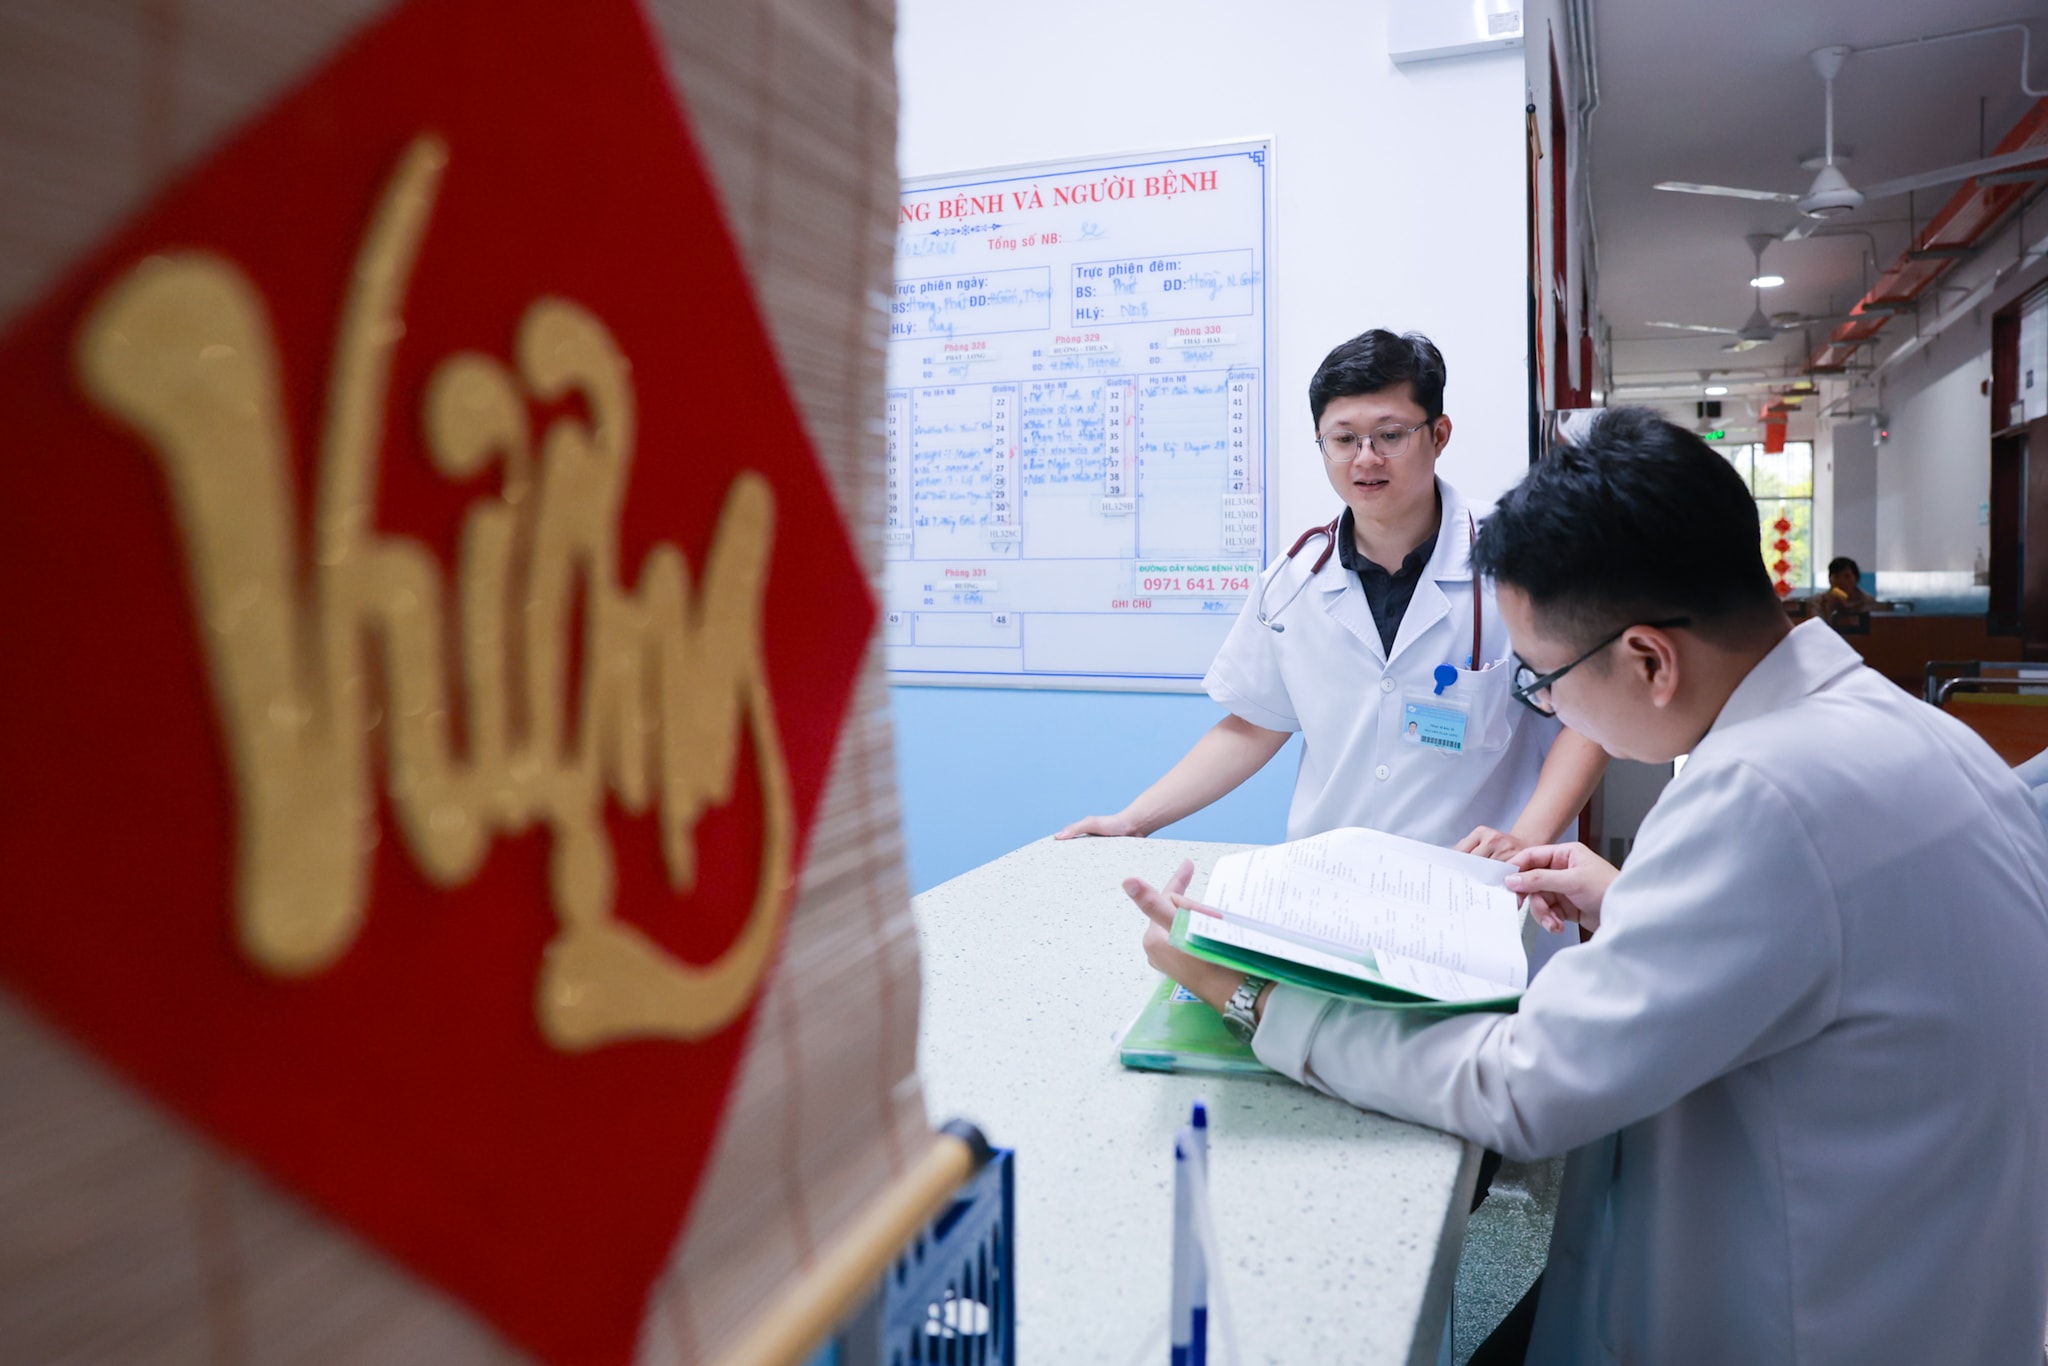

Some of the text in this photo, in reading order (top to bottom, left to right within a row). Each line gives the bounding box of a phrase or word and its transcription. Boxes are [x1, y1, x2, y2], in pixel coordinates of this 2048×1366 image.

[899, 169, 1218, 224] NG BỆNH VÀ NGƯỜI BỆNH
[988, 232, 1062, 251] Tổng số NB:
[1076, 260, 1181, 280] Trực phiên đêm:
[920, 279, 951, 295] phiên
[957, 276, 988, 291] ngày:
[1163, 279, 1187, 292] ĐD:
[1076, 286, 1096, 298] BS:
[969, 295, 990, 308] ĐD:
[1076, 307, 1104, 321] HLý:
[1174, 325, 1221, 336] Phòng 330
[1055, 333, 1100, 344] Phòng 329
[944, 343, 968, 353] Phòng
[1232, 384, 1243, 392] 40
[996, 398, 1005, 406] 22
[1232, 398, 1243, 406] 41
[996, 411, 1005, 419] 23
[1232, 412, 1243, 420] 42
[1110, 419, 1119, 427] 34
[1232, 426, 1243, 434] 43
[1232, 440, 1243, 448] 44
[1110, 446, 1119, 454] 36
[996, 451, 1005, 459] 26
[1232, 455, 1243, 463] 45
[996, 464, 1005, 472] 27
[1110, 473, 1119, 481] 38
[1232, 469, 1243, 477] 46
[1110, 486, 1119, 494] 39
[1232, 482, 1243, 490] 47
[996, 491, 1005, 499] 29
[1224, 498, 1258, 506] HL330C
[996, 503, 1005, 511] 30
[1224, 511, 1259, 519] HL330D
[1224, 524, 1258, 533] HL330E
[1139, 563, 1254, 573] ĐƯỜNG DÂY NÓNG BỆNH VIỆN
[945, 568, 987, 578] Phòng 331
[1144, 578, 1249, 591] 0971 641 764
[1111, 598, 1152, 609] GHI CHÚ
[889, 615, 899, 623] 49
[996, 616, 1007, 624] 48
